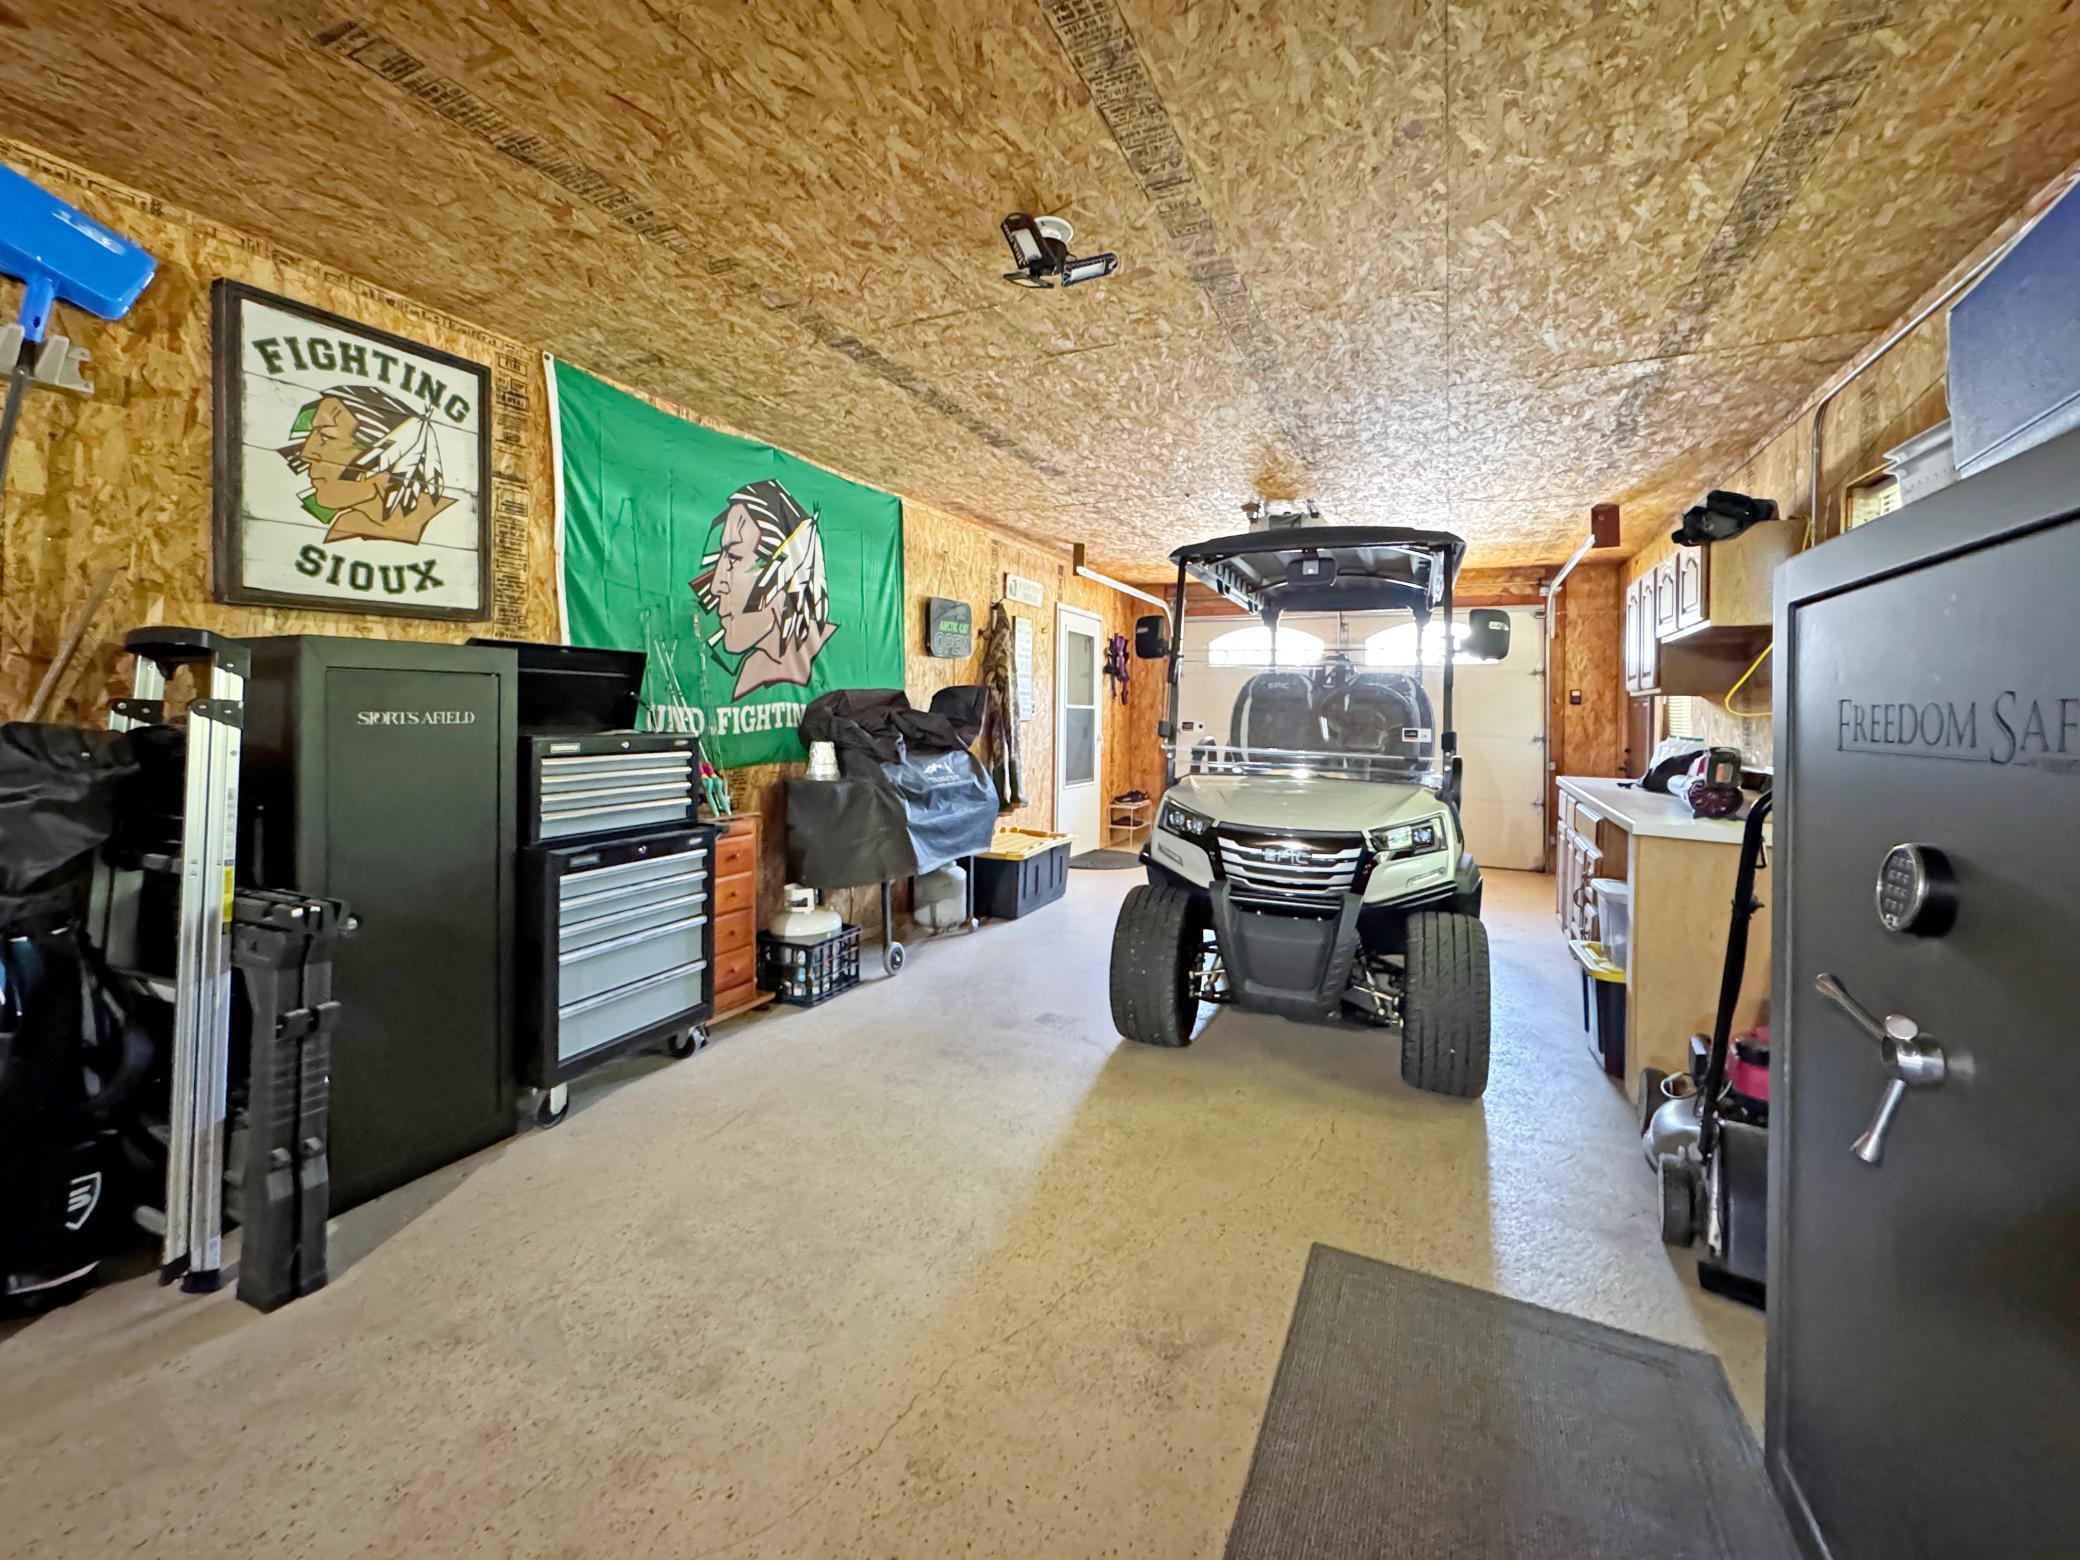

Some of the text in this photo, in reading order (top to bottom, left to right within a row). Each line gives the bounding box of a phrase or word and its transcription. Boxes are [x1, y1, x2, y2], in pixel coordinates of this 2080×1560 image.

[251, 336, 471, 424] FIGHTING
[295, 543, 445, 595] SIOUX
[935, 632, 971, 656] OPEN
[357, 711, 476, 725] SPORTS AFIELD
[1836, 699, 1977, 752] FREEDOM
